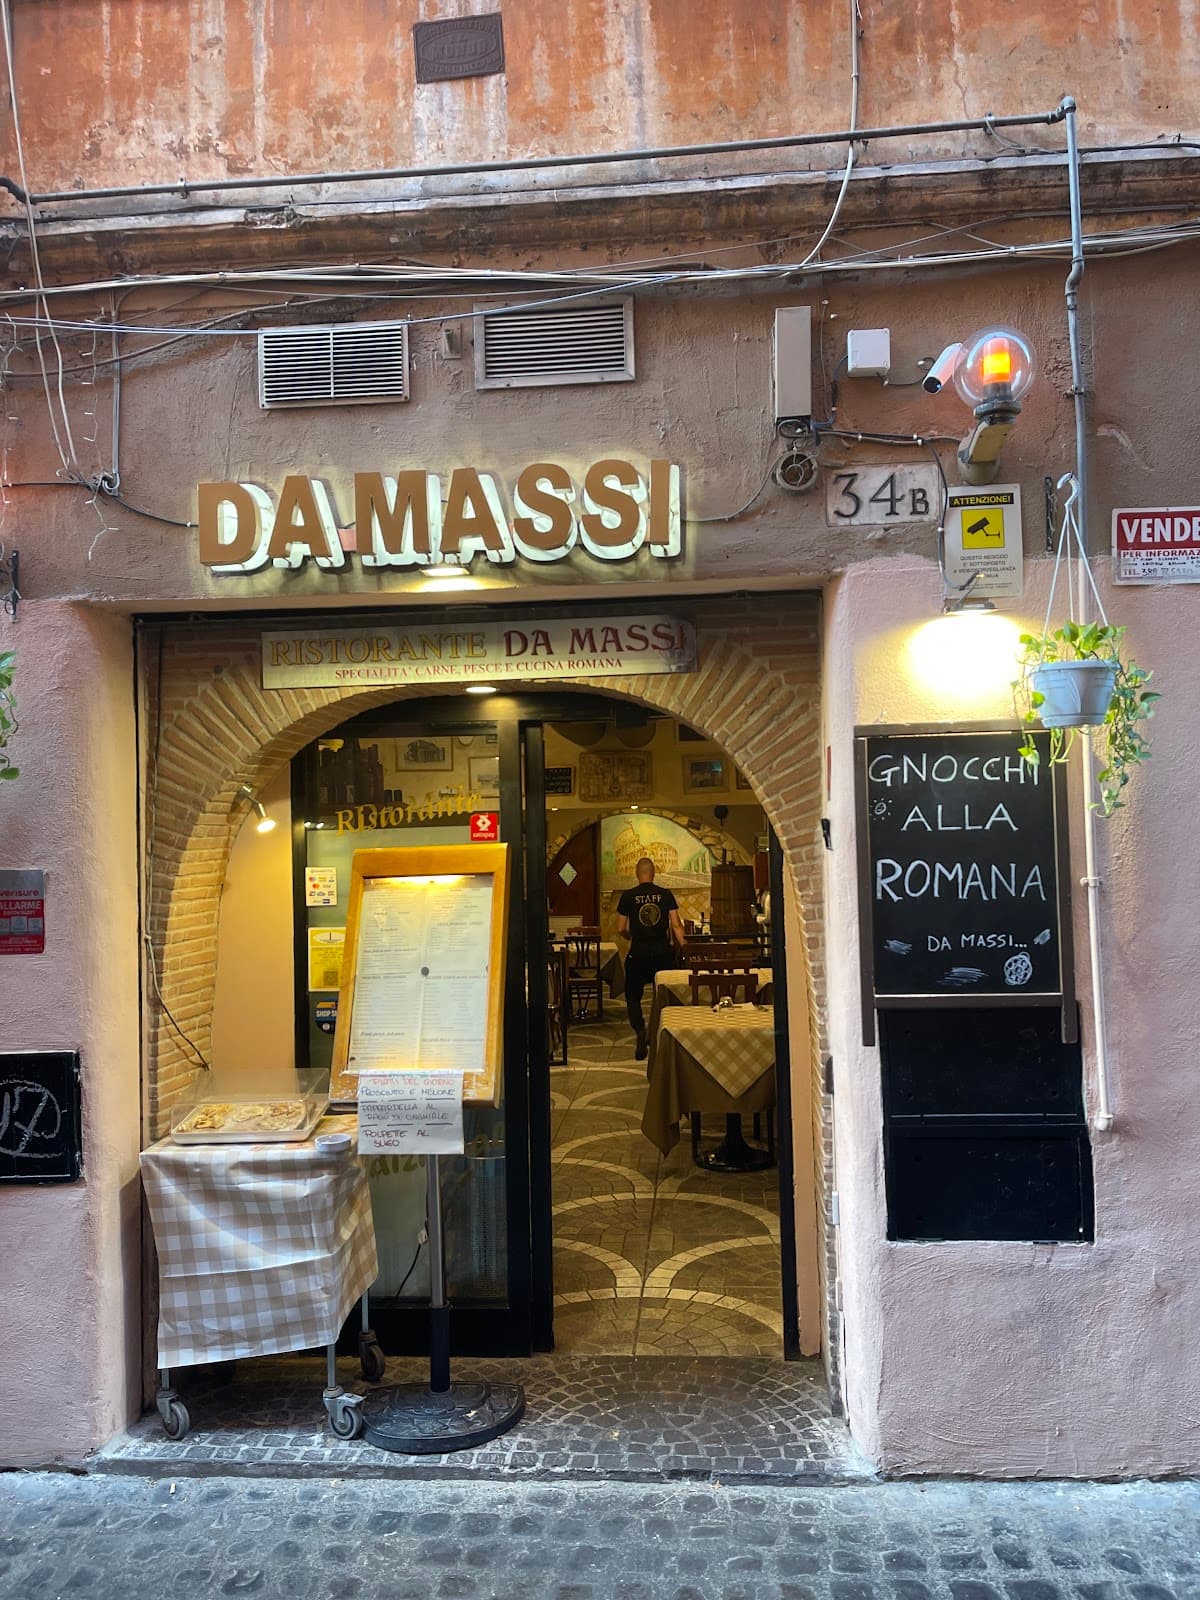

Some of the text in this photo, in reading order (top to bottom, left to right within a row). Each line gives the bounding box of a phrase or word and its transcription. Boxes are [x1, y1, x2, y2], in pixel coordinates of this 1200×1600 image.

[953, 495, 1011, 505] ATTENZIONE!
[199, 458, 679, 568] DA MASSI
[1120, 516, 1200, 544] VENDE
[270, 623, 686, 666] RISTORANTE DA MASSI
[463, 663, 501, 674] PESCE
[504, 662, 515, 672] E
[516, 660, 564, 672] CUCINA
[567, 658, 623, 670] ROMANA
[868, 752, 1040, 787] GNOCCHI
[901, 802, 1019, 832] ALLA
[876, 858, 1047, 903] ROMANA
[635, 894, 663, 904] STAFF
[927, 933, 1028, 952] DA MASSI...
[421, 1087, 456, 1096] MELONE
[362, 1129, 430, 1138] POLPETTE AL
[374, 1139, 400, 1148] SUGO
